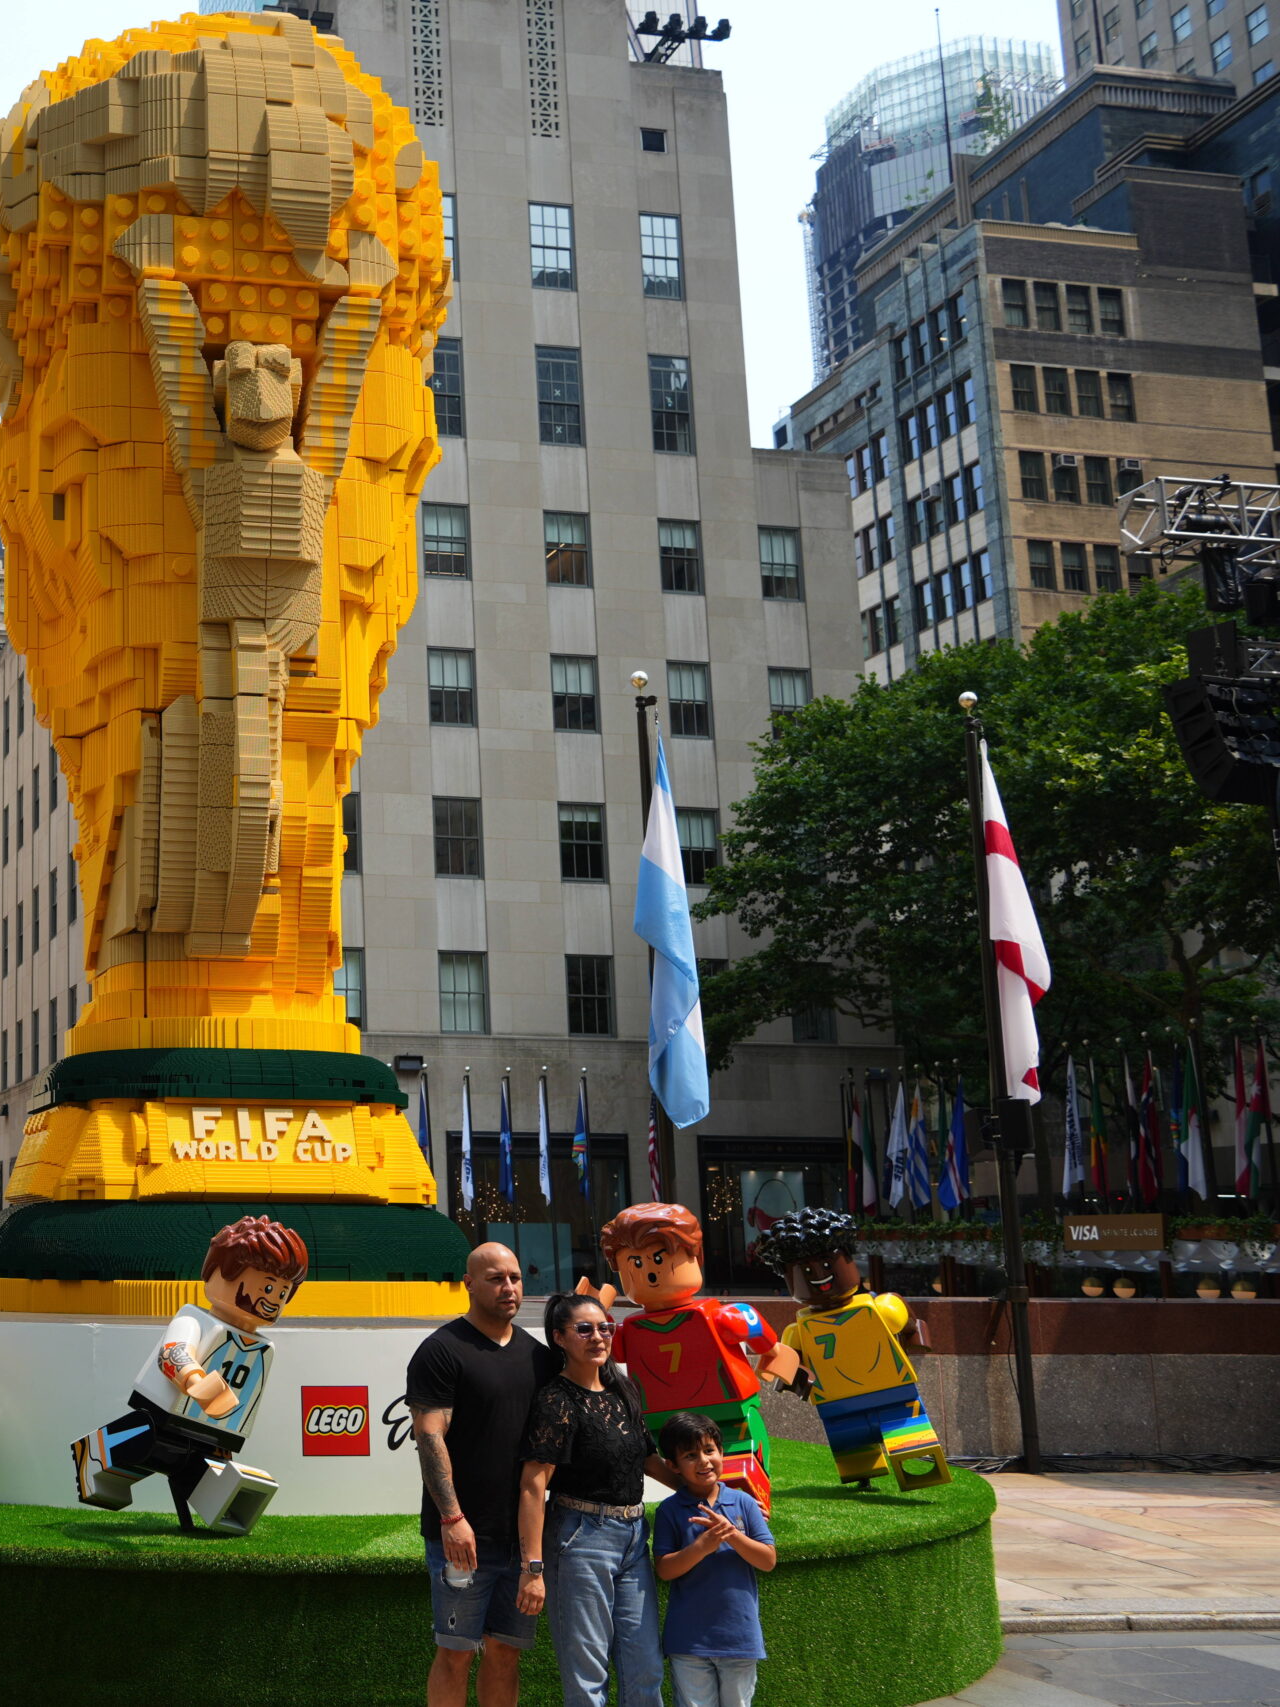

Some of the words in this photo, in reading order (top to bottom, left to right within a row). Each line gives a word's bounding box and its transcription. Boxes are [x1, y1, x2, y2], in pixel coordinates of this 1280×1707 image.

[192, 1107, 332, 1141] FIFA
[174, 1141, 279, 1161] WORLD
[296, 1141, 353, 1162] CUP
[1068, 1225, 1099, 1241] VISA
[658, 1342, 682, 1373] 7
[814, 1333, 836, 1359] 7
[221, 1360, 251, 1389] 10
[306, 1405, 366, 1435] LEGO
[733, 1422, 748, 1440] 7
